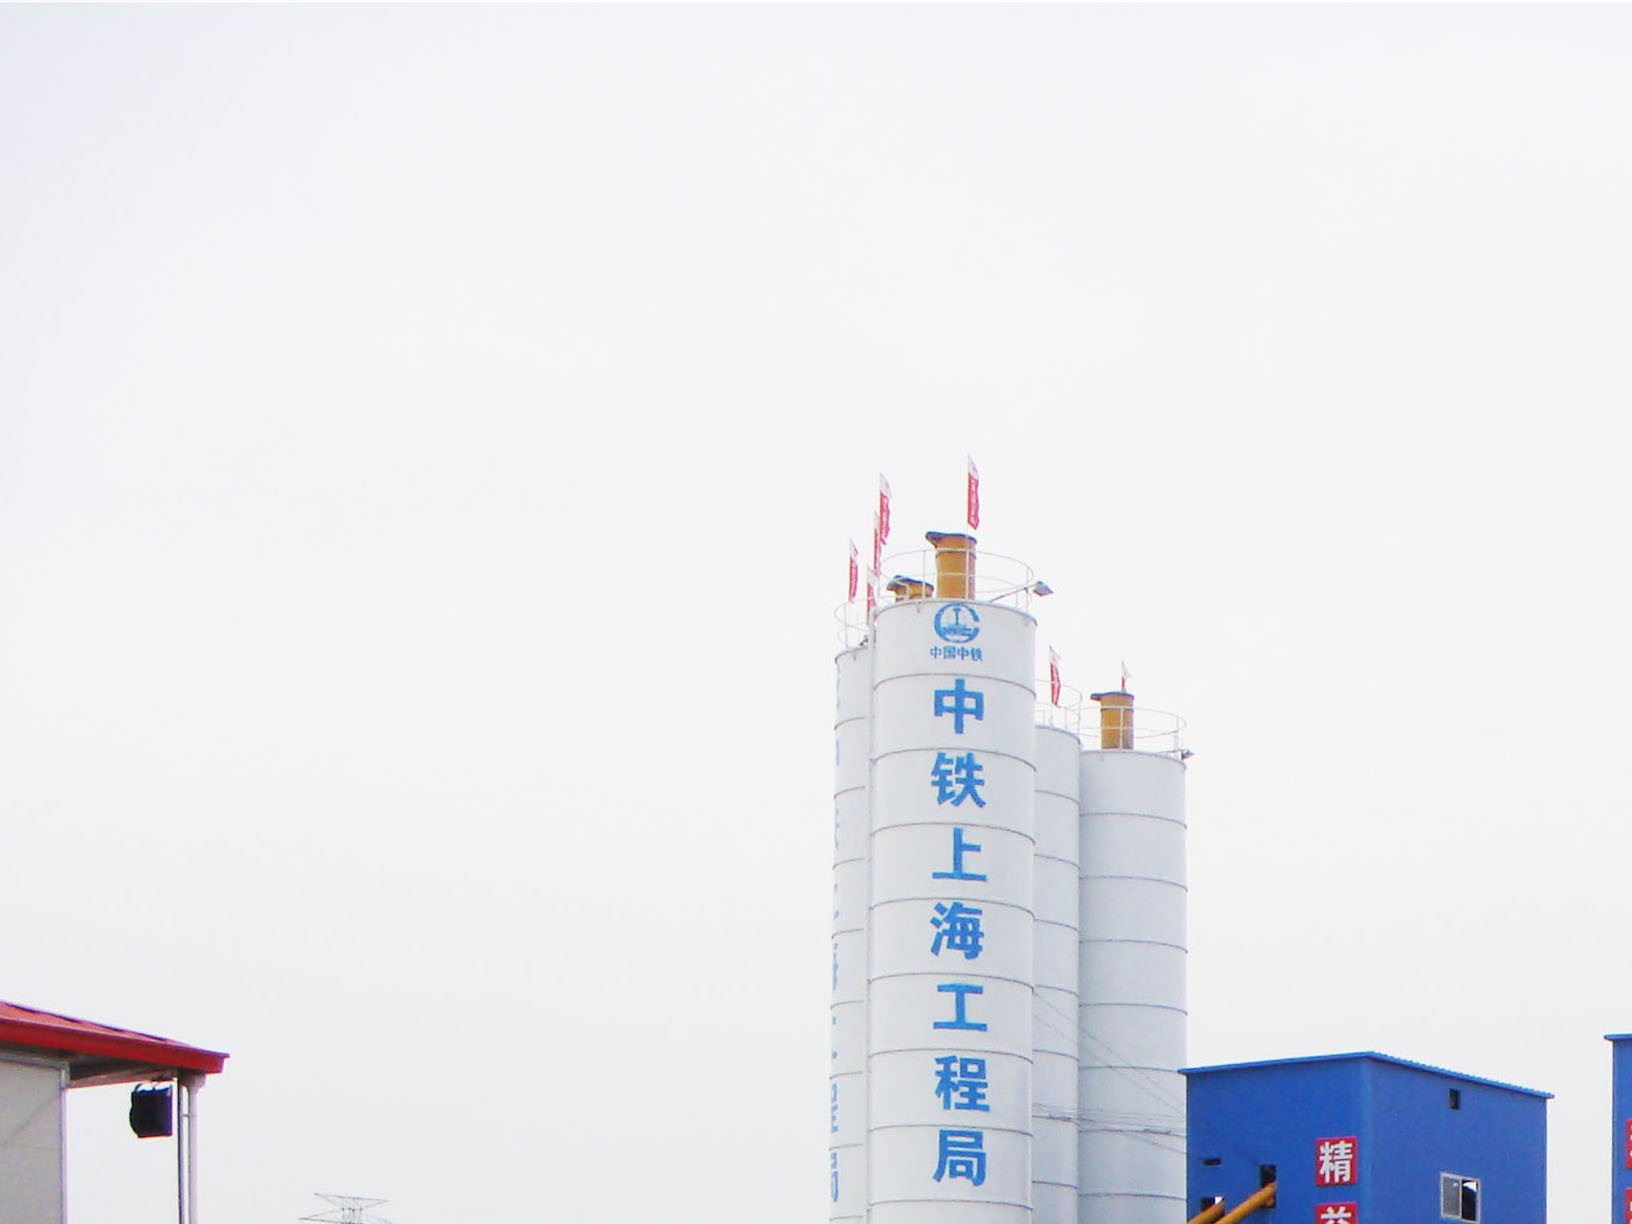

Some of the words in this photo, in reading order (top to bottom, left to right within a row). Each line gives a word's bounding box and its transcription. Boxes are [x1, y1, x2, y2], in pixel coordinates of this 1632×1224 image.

[930, 678, 990, 1187] 中铁上海工程局
